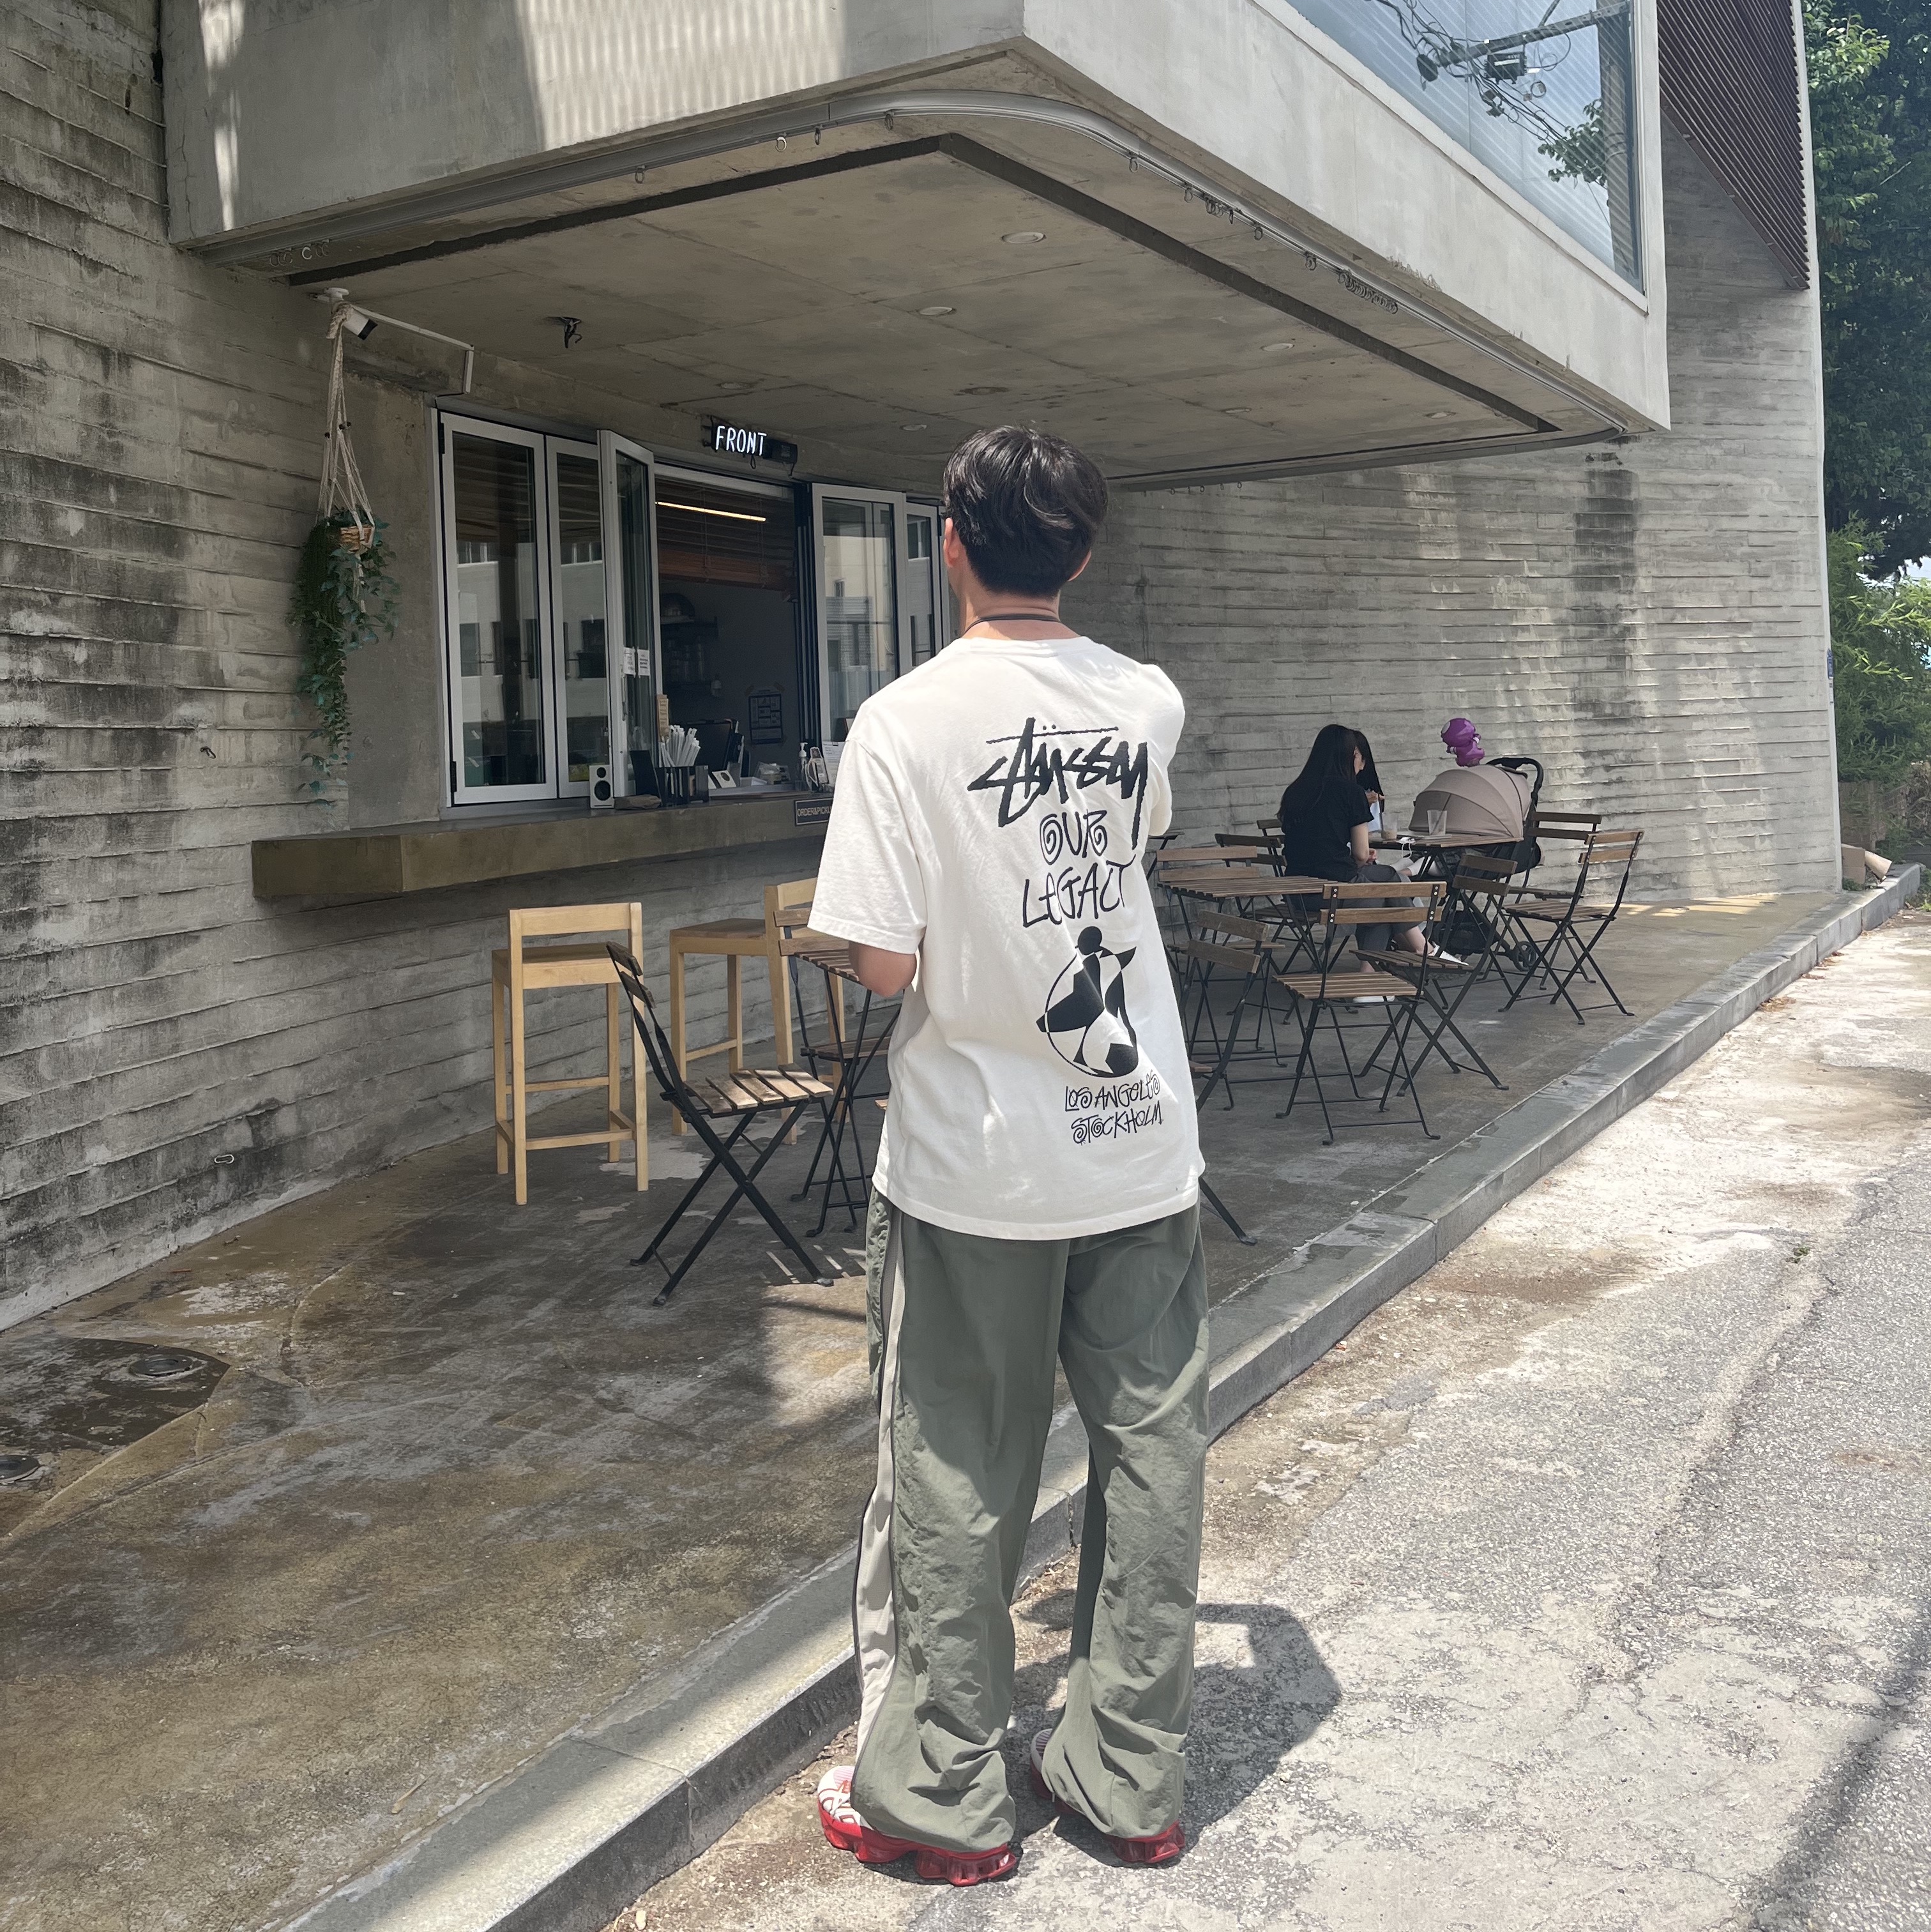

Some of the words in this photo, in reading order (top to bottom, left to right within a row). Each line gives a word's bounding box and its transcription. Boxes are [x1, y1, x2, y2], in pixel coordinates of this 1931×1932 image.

[715, 425, 767, 456] FRONT
[1040, 809, 1107, 865] OUR
[1065, 1086, 1093, 1112] LOS
[1071, 1100, 1163, 1145] STOCKHOLM
